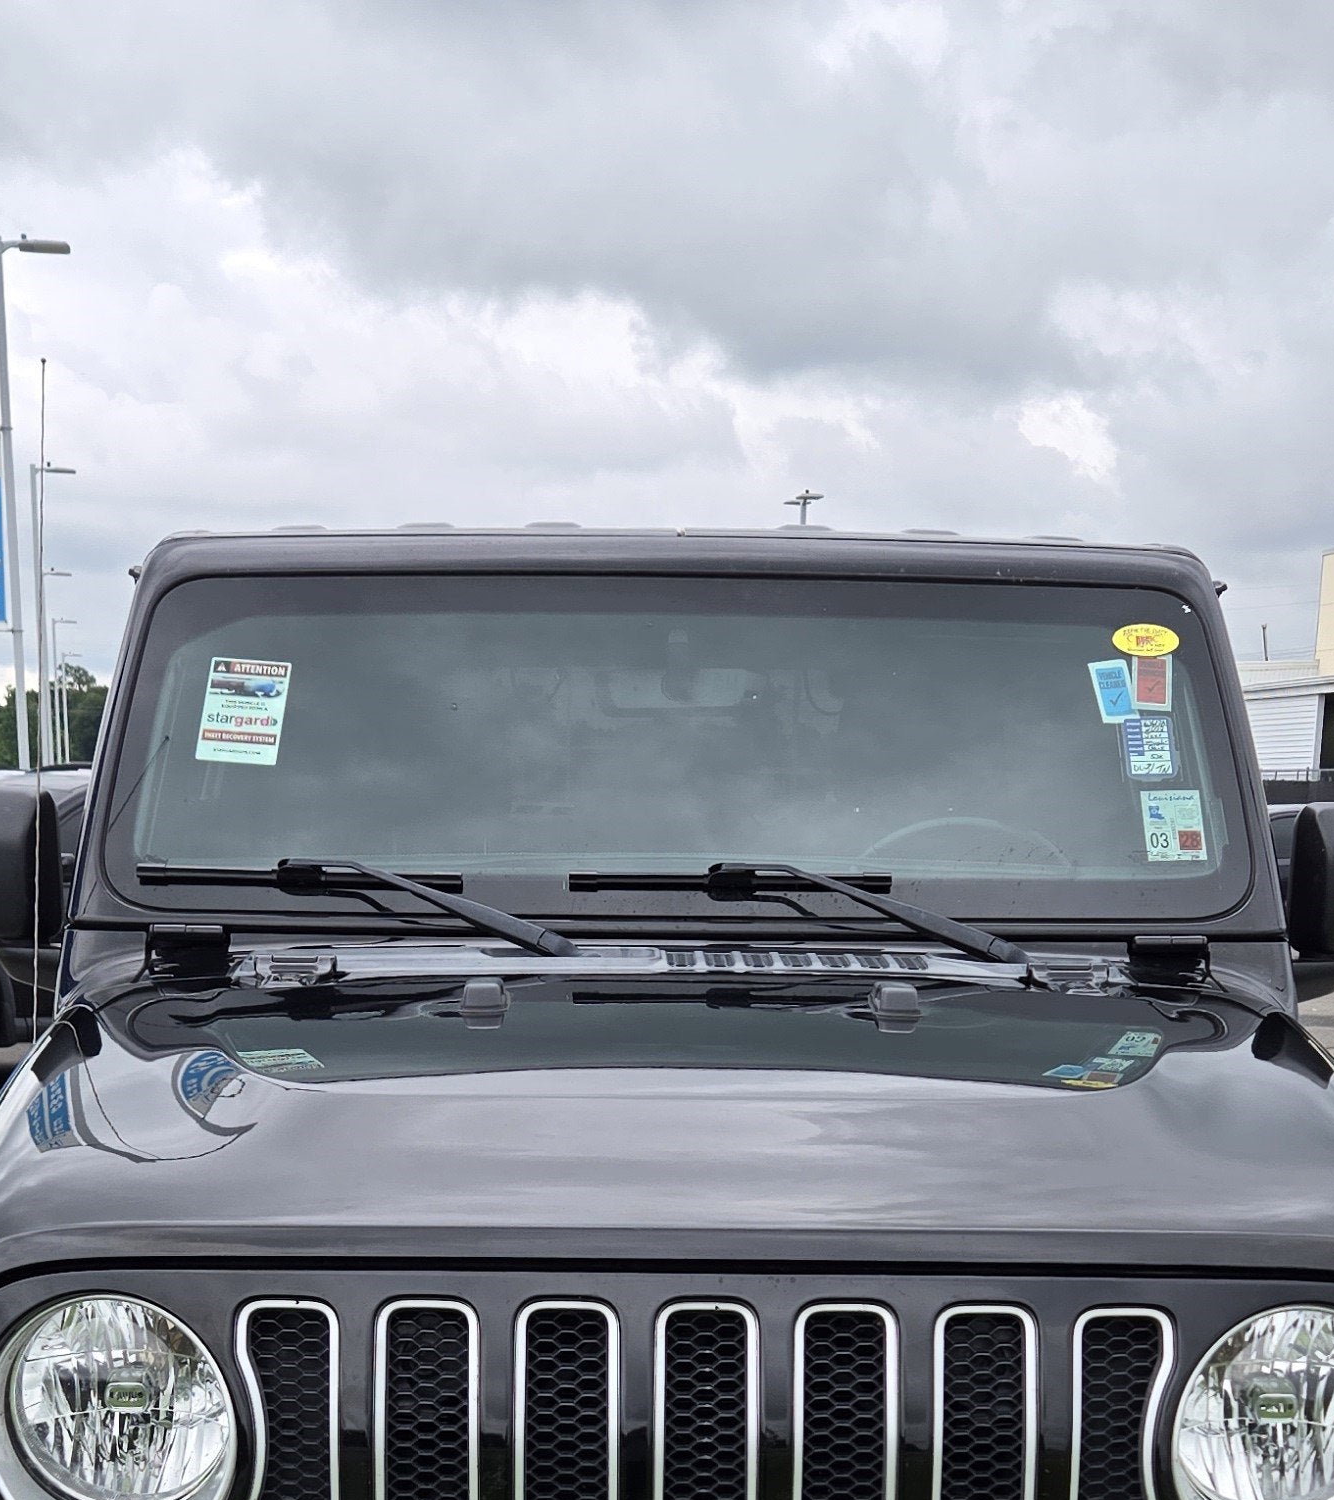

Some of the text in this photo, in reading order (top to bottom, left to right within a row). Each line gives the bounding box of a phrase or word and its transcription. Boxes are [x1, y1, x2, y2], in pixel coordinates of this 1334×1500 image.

[233, 663, 286, 676] ATTENTION
[1148, 792, 1195, 802] Louisiana
[1150, 832, 1169, 849] 03
